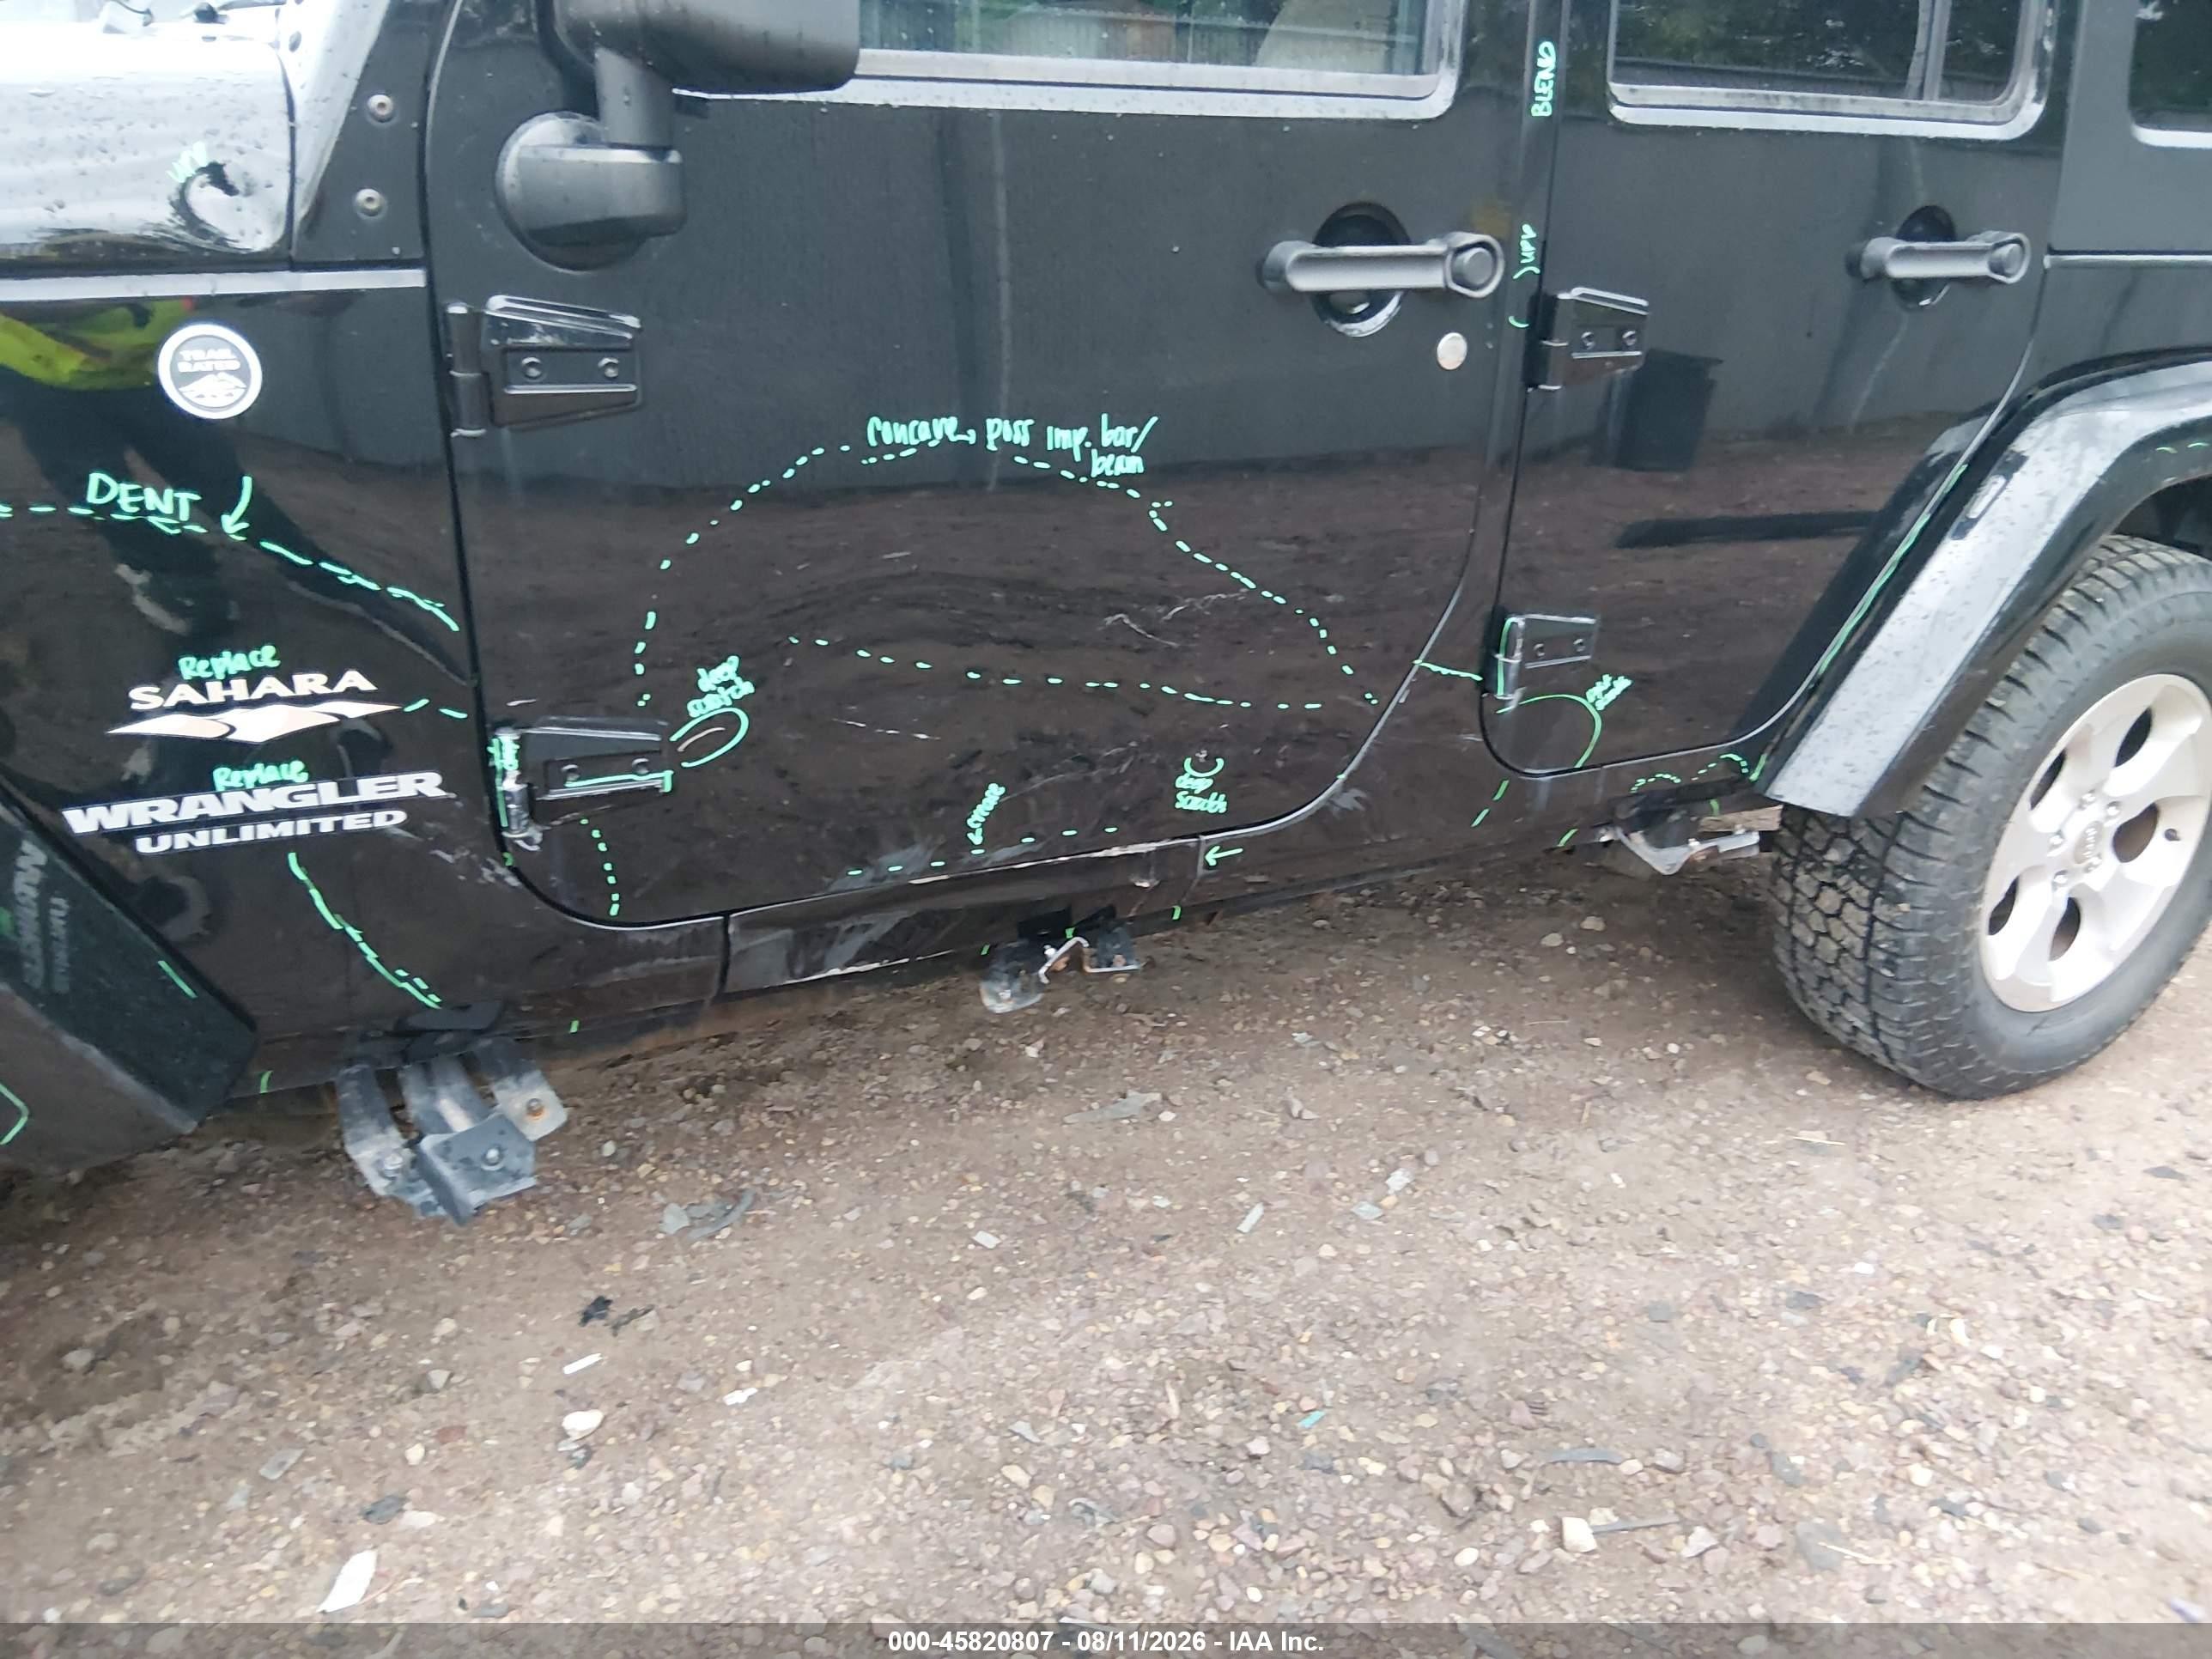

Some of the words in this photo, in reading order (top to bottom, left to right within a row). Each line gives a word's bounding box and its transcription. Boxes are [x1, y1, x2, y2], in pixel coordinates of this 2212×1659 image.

[1531, 40, 1556, 117] BLEND
[87, 471, 202, 521] DENT
[178, 645, 281, 681] Replace
[129, 670, 378, 711] SAHARA
[62, 772, 449, 835] WRANGLER
[136, 810, 408, 854] UNLIMITED
